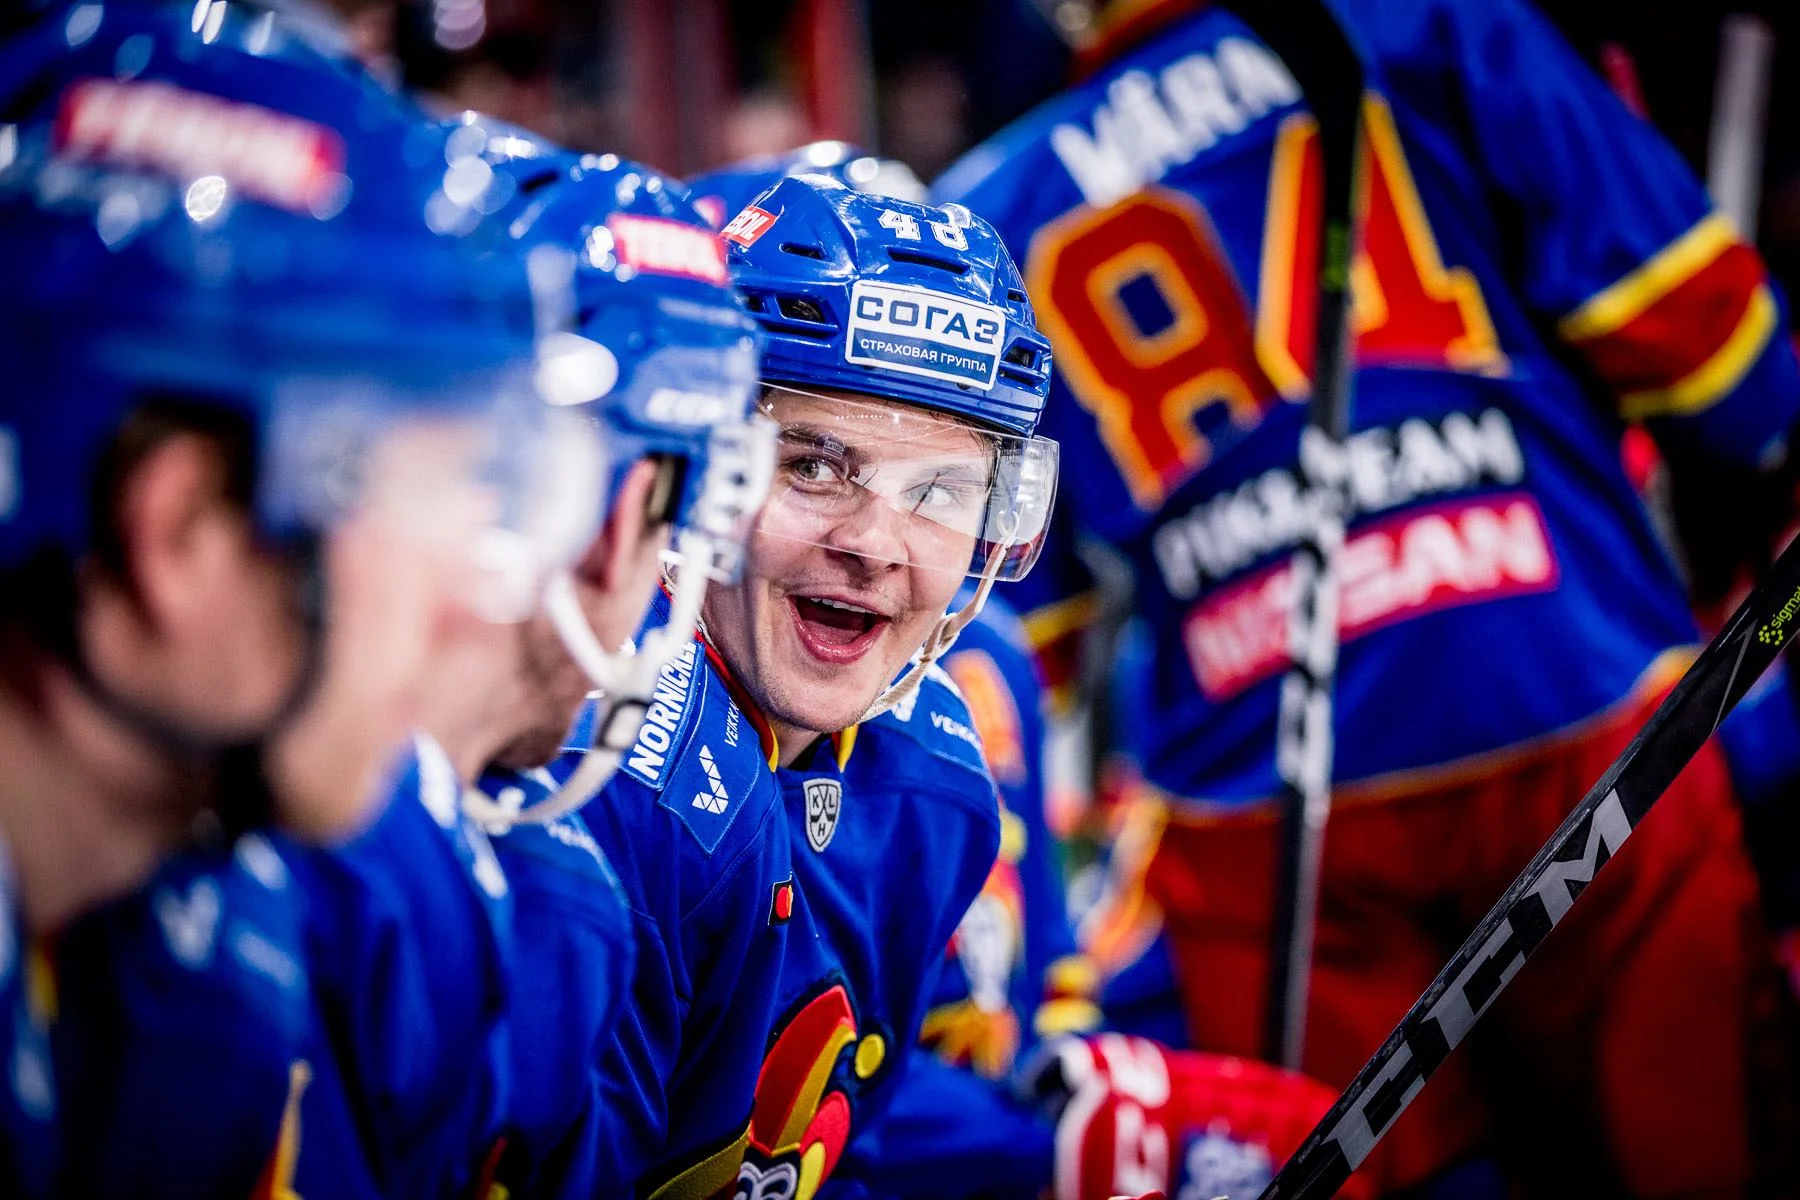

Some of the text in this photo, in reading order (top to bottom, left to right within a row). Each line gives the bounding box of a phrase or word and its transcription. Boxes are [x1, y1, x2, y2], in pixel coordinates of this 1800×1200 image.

[856, 295, 1000, 344] СОГАЗ
[860, 338, 988, 374] СТРАХОВАЯ ГРУППА
[1771, 586, 1800, 629] sigma
[1320, 788, 1632, 1172] CCM
